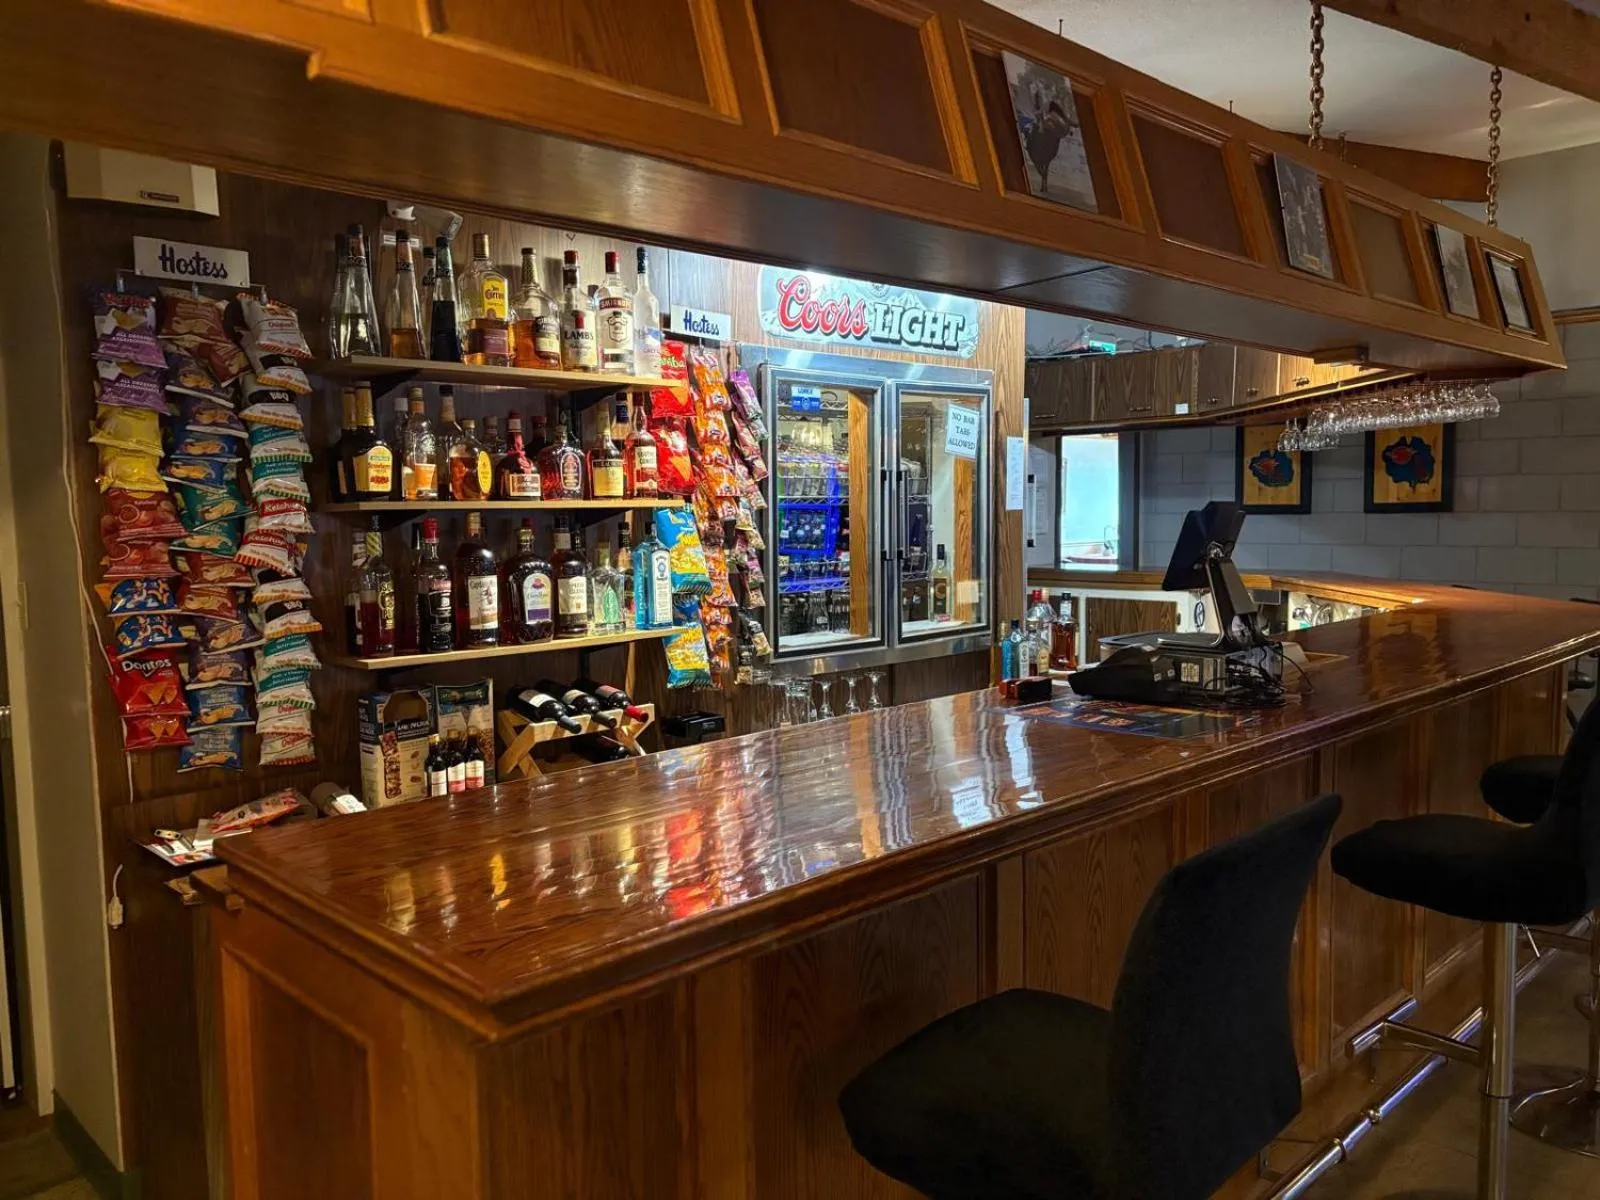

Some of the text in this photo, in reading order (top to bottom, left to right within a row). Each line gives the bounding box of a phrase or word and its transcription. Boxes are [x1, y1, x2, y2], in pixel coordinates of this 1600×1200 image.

[158, 244, 228, 278] Hostess
[683, 309, 720, 336] Hostess
[777, 275, 965, 350] Coors LIGHT
[952, 411, 962, 421] NO
[121, 657, 172, 675] Doritos
